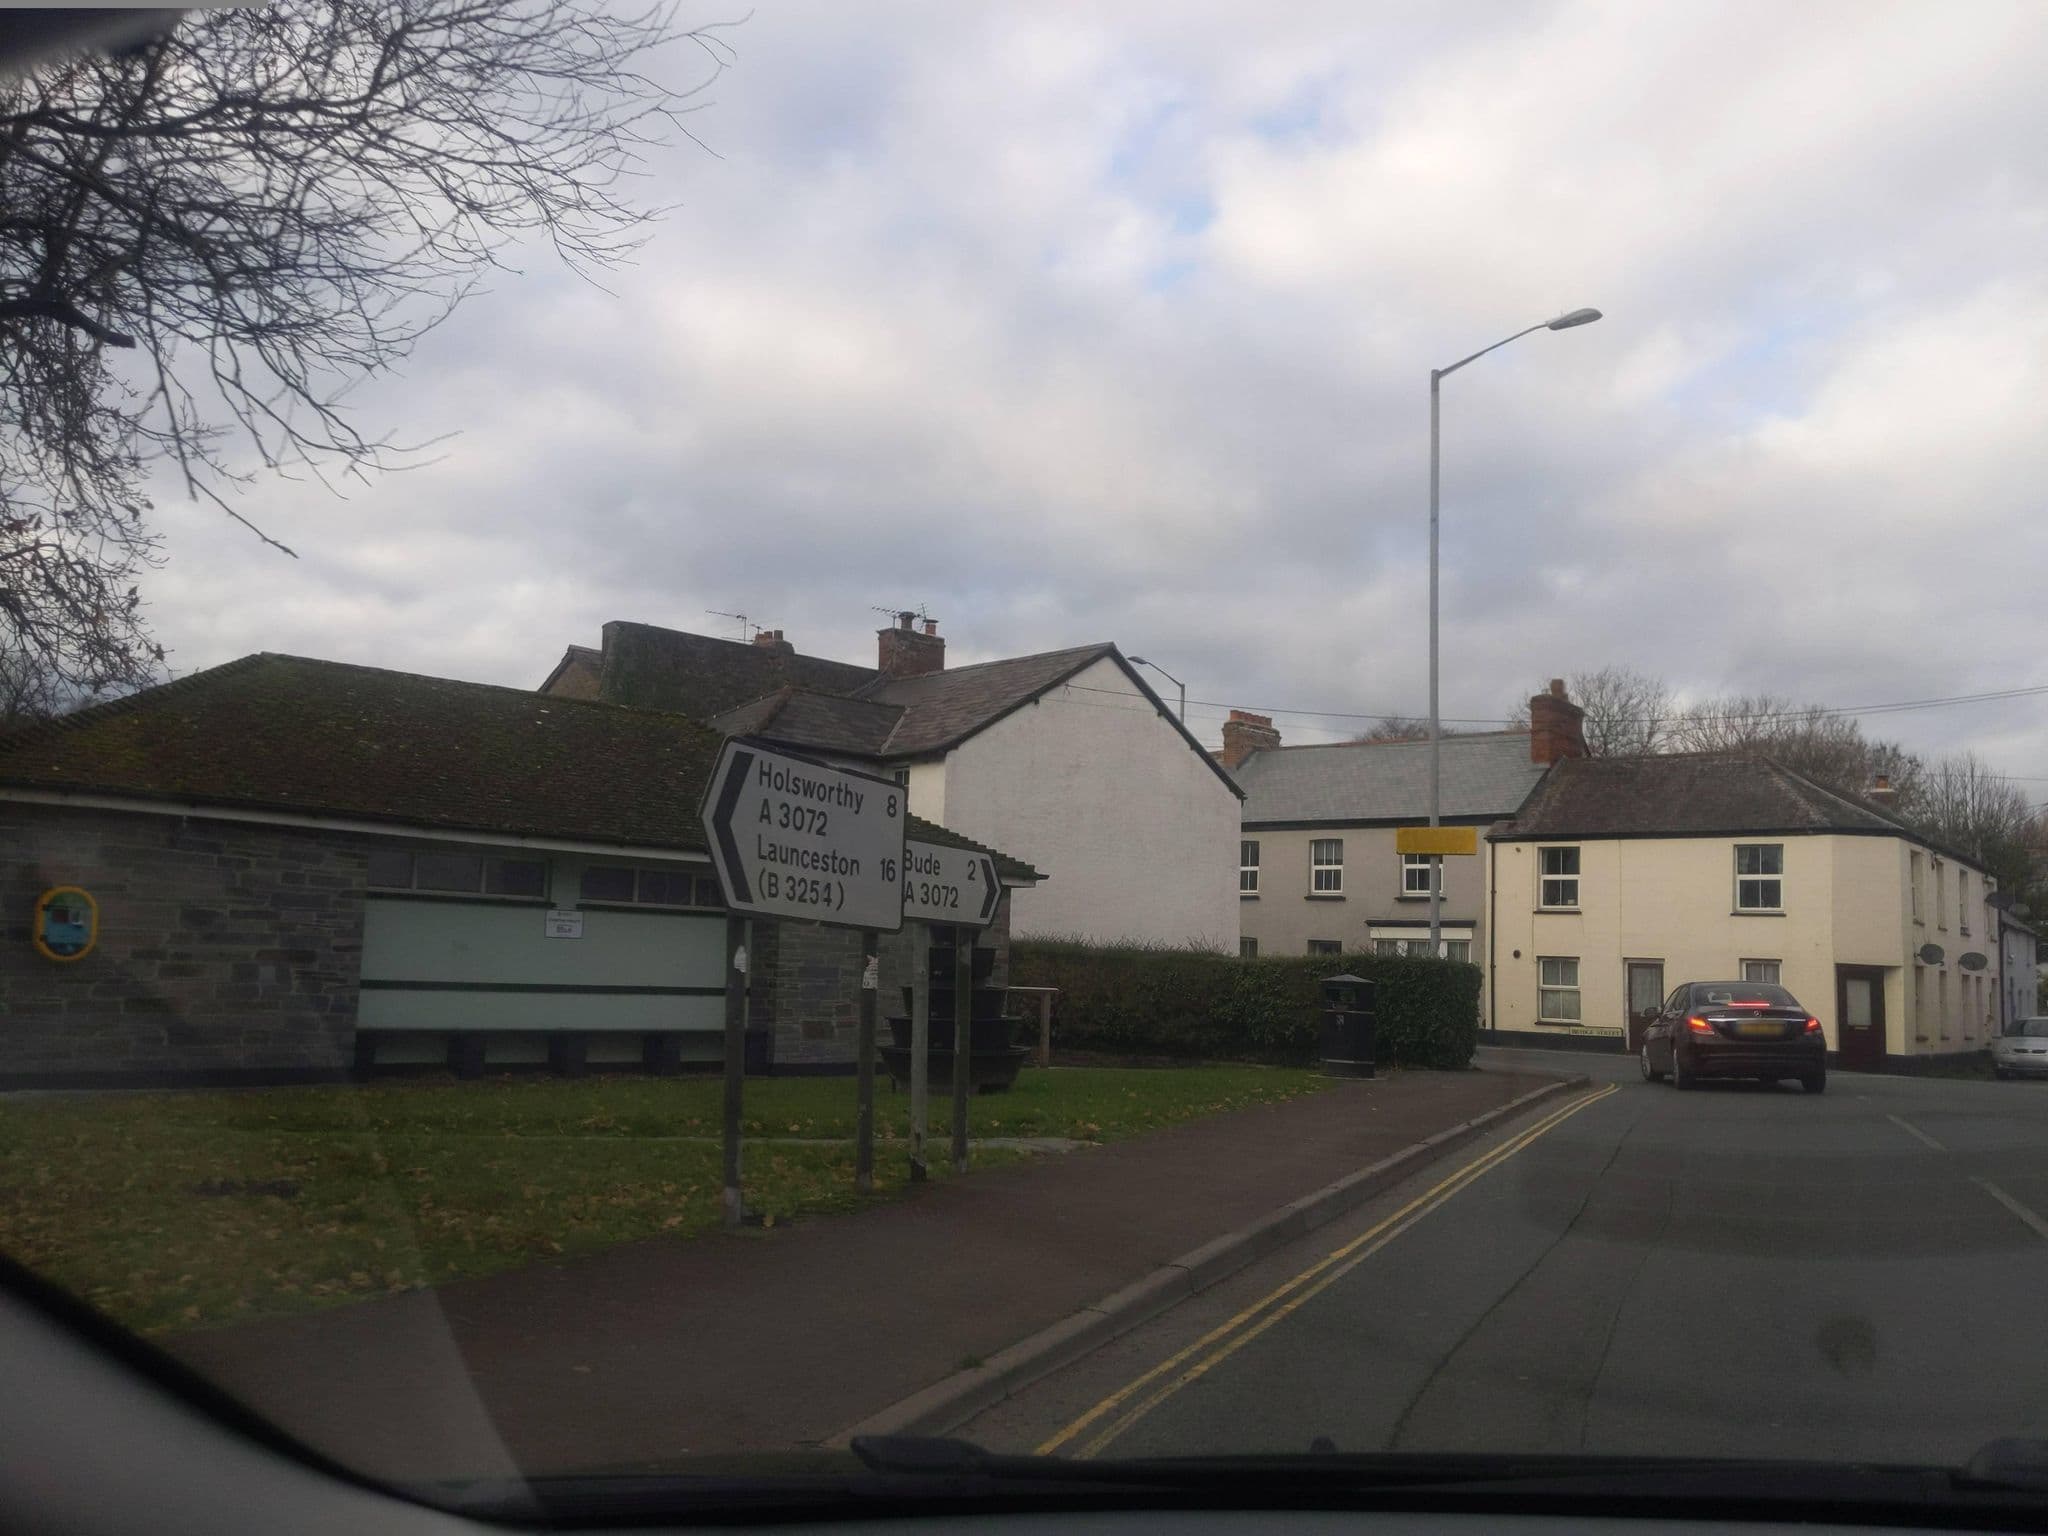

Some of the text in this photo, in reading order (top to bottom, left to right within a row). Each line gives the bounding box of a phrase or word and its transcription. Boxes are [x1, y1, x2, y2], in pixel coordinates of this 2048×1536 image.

[759, 760, 898, 818] Holsworthy 8
[759, 799, 828, 837] A 3072
[757, 833, 896, 882] Launceston 16
[904, 849, 976, 881] Bude 2
[758, 867, 779, 900] (B
[904, 881, 958, 908] A 3072
